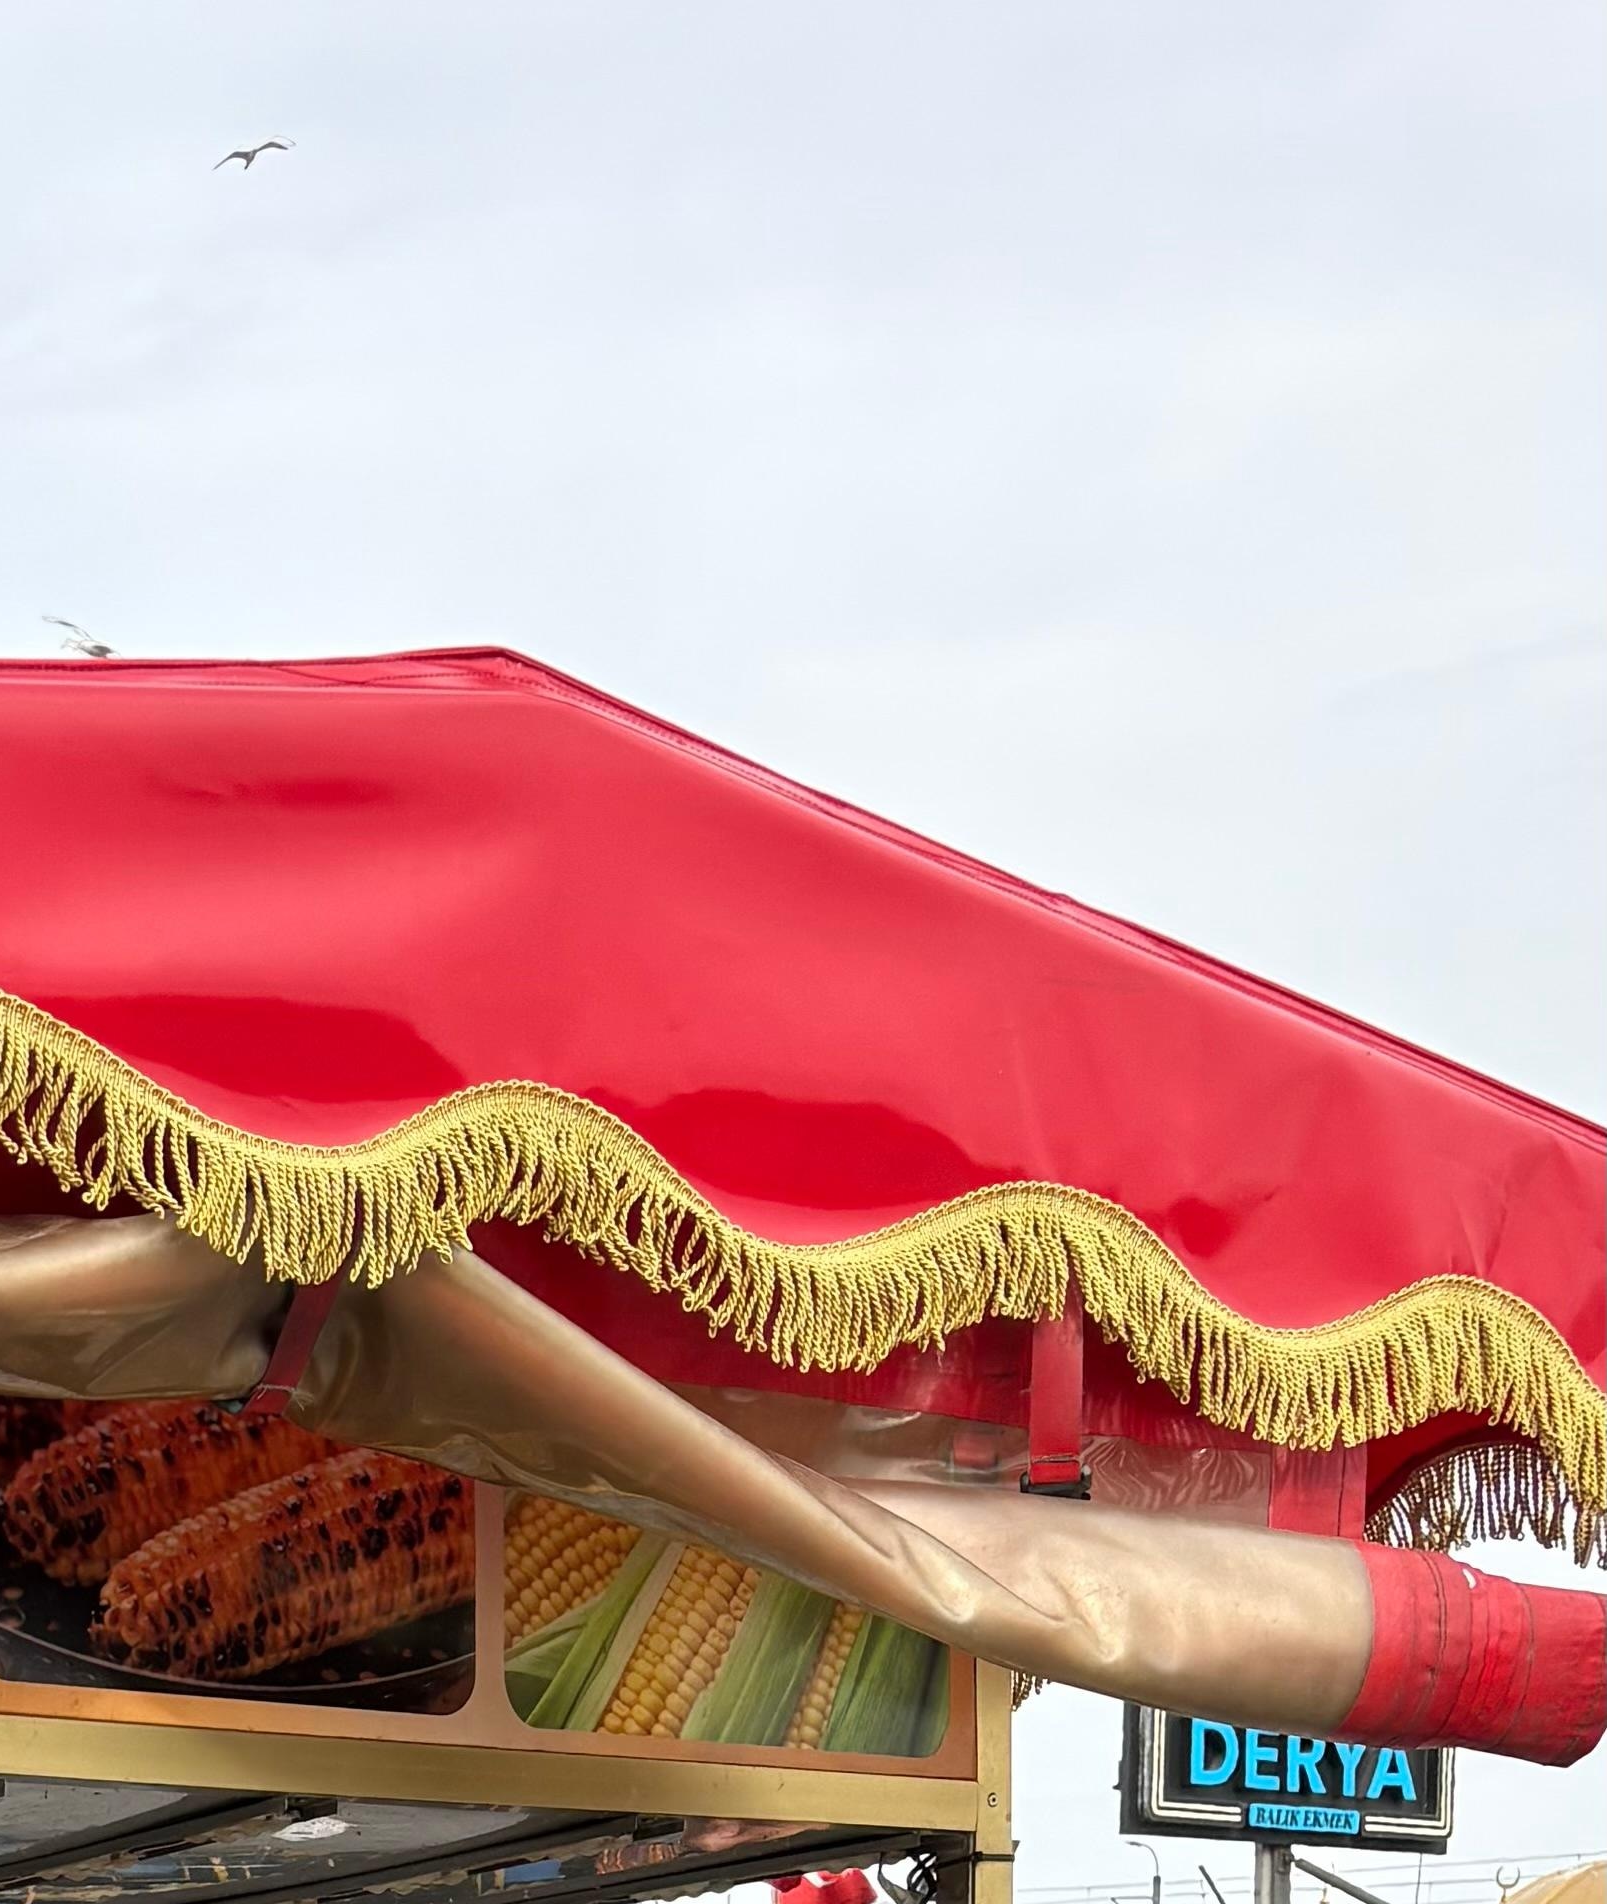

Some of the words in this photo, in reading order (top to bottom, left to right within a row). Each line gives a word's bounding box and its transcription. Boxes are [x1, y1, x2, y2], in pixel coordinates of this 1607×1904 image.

[1190, 1717, 1417, 1801] DERYA
[1256, 1807, 1300, 1827] BALIK
[1303, 1810, 1354, 1830] EKMEK
